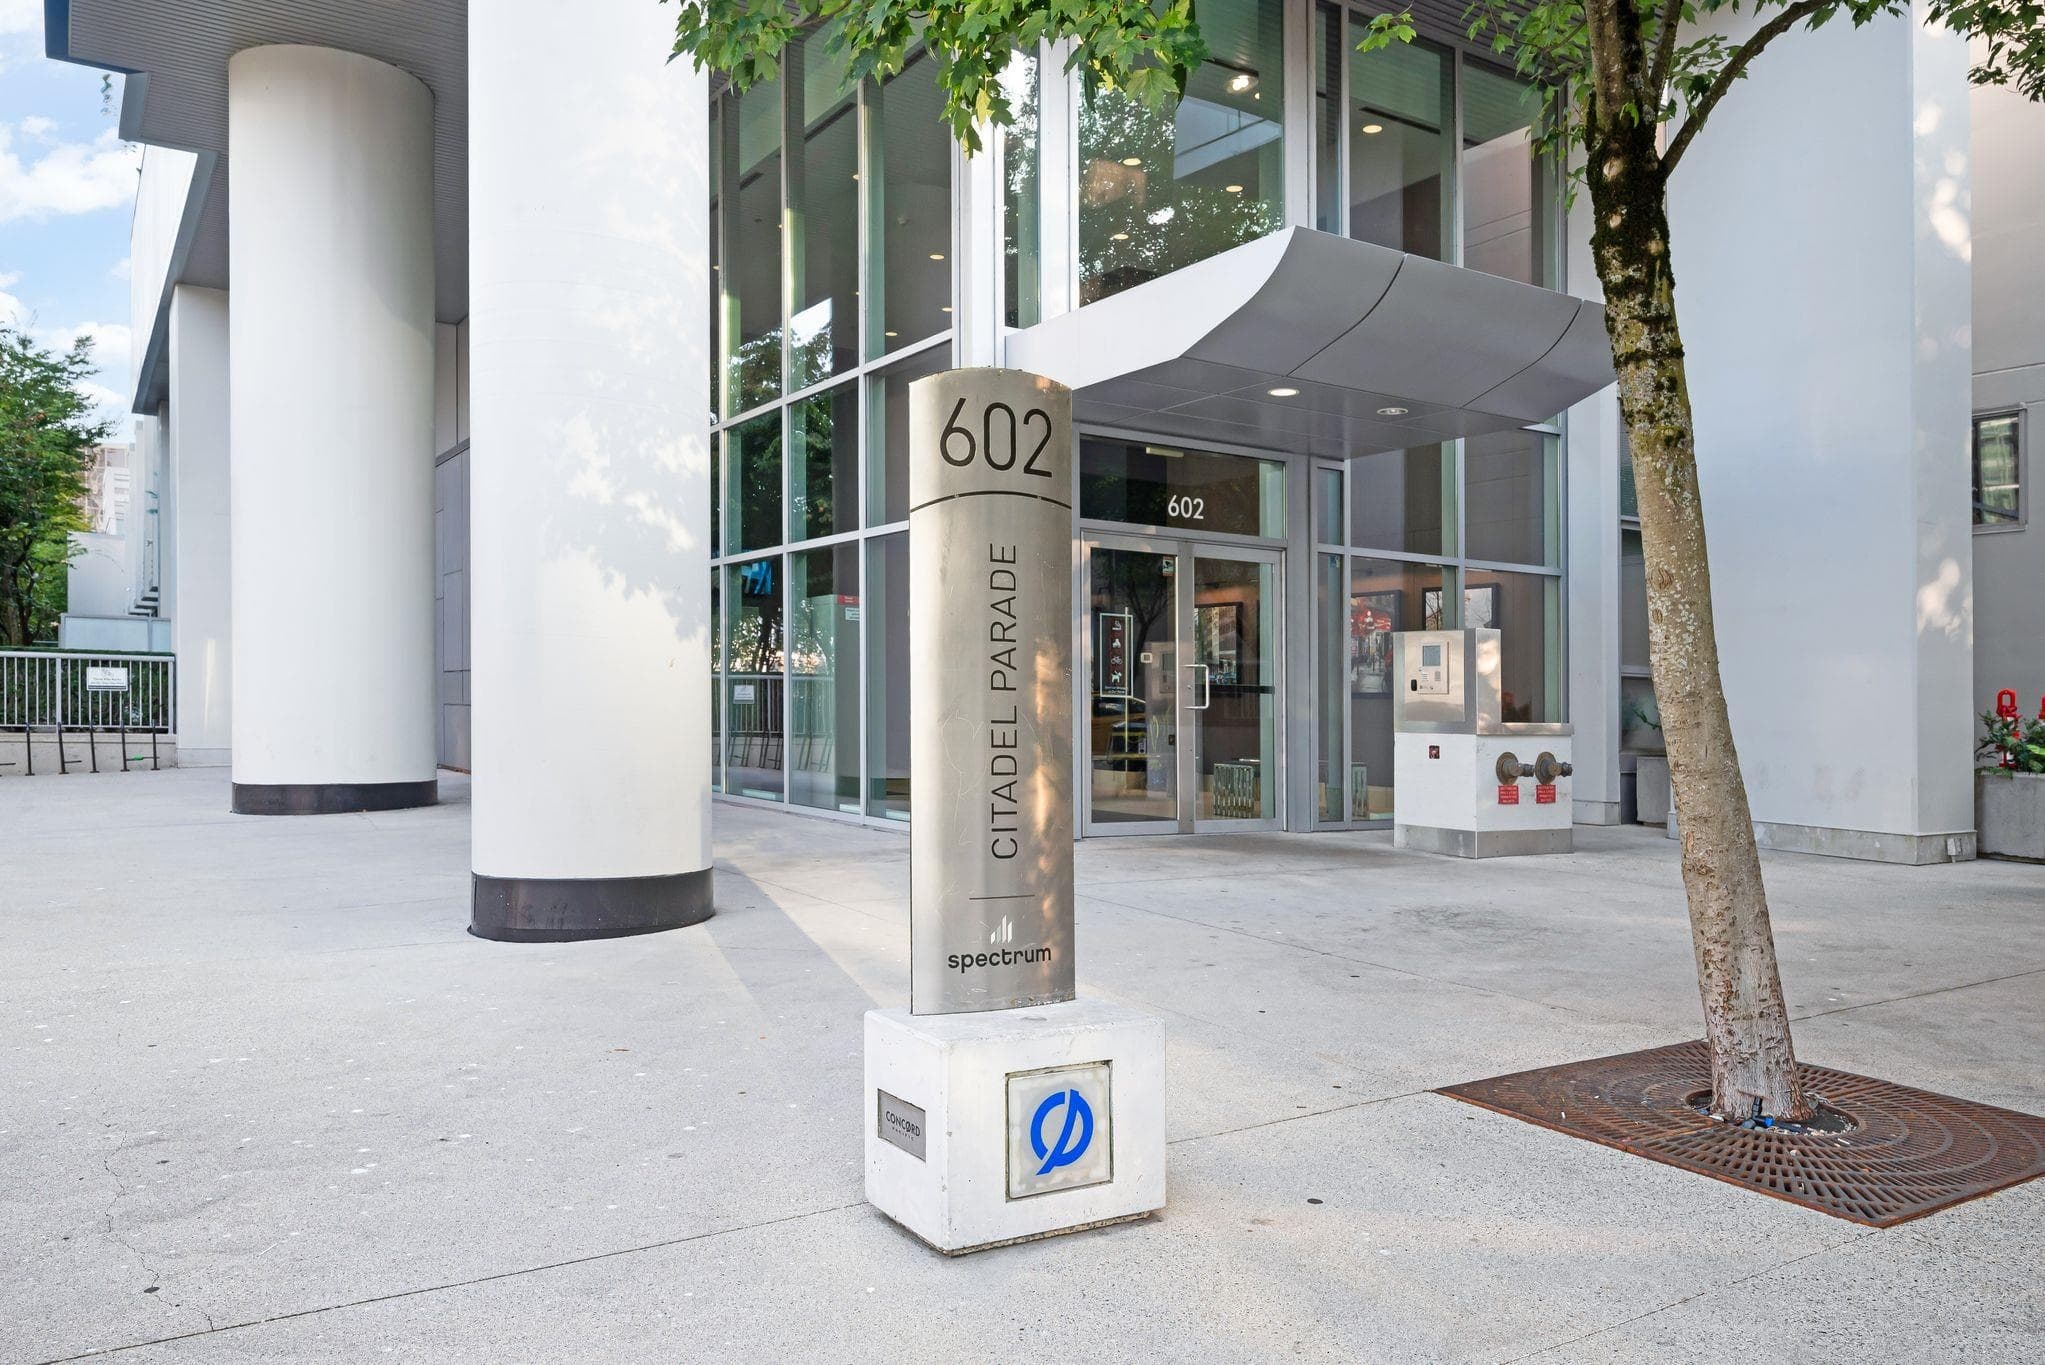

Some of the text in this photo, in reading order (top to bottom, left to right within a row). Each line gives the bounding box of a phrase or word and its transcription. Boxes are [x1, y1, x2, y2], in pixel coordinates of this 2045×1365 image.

[939, 397, 1053, 478] 602
[1167, 494, 1205, 520] 602
[989, 542, 1018, 861] CITADEL PARADE
[947, 945, 1052, 974] spectrum
[885, 1110, 921, 1137] CONCORD
